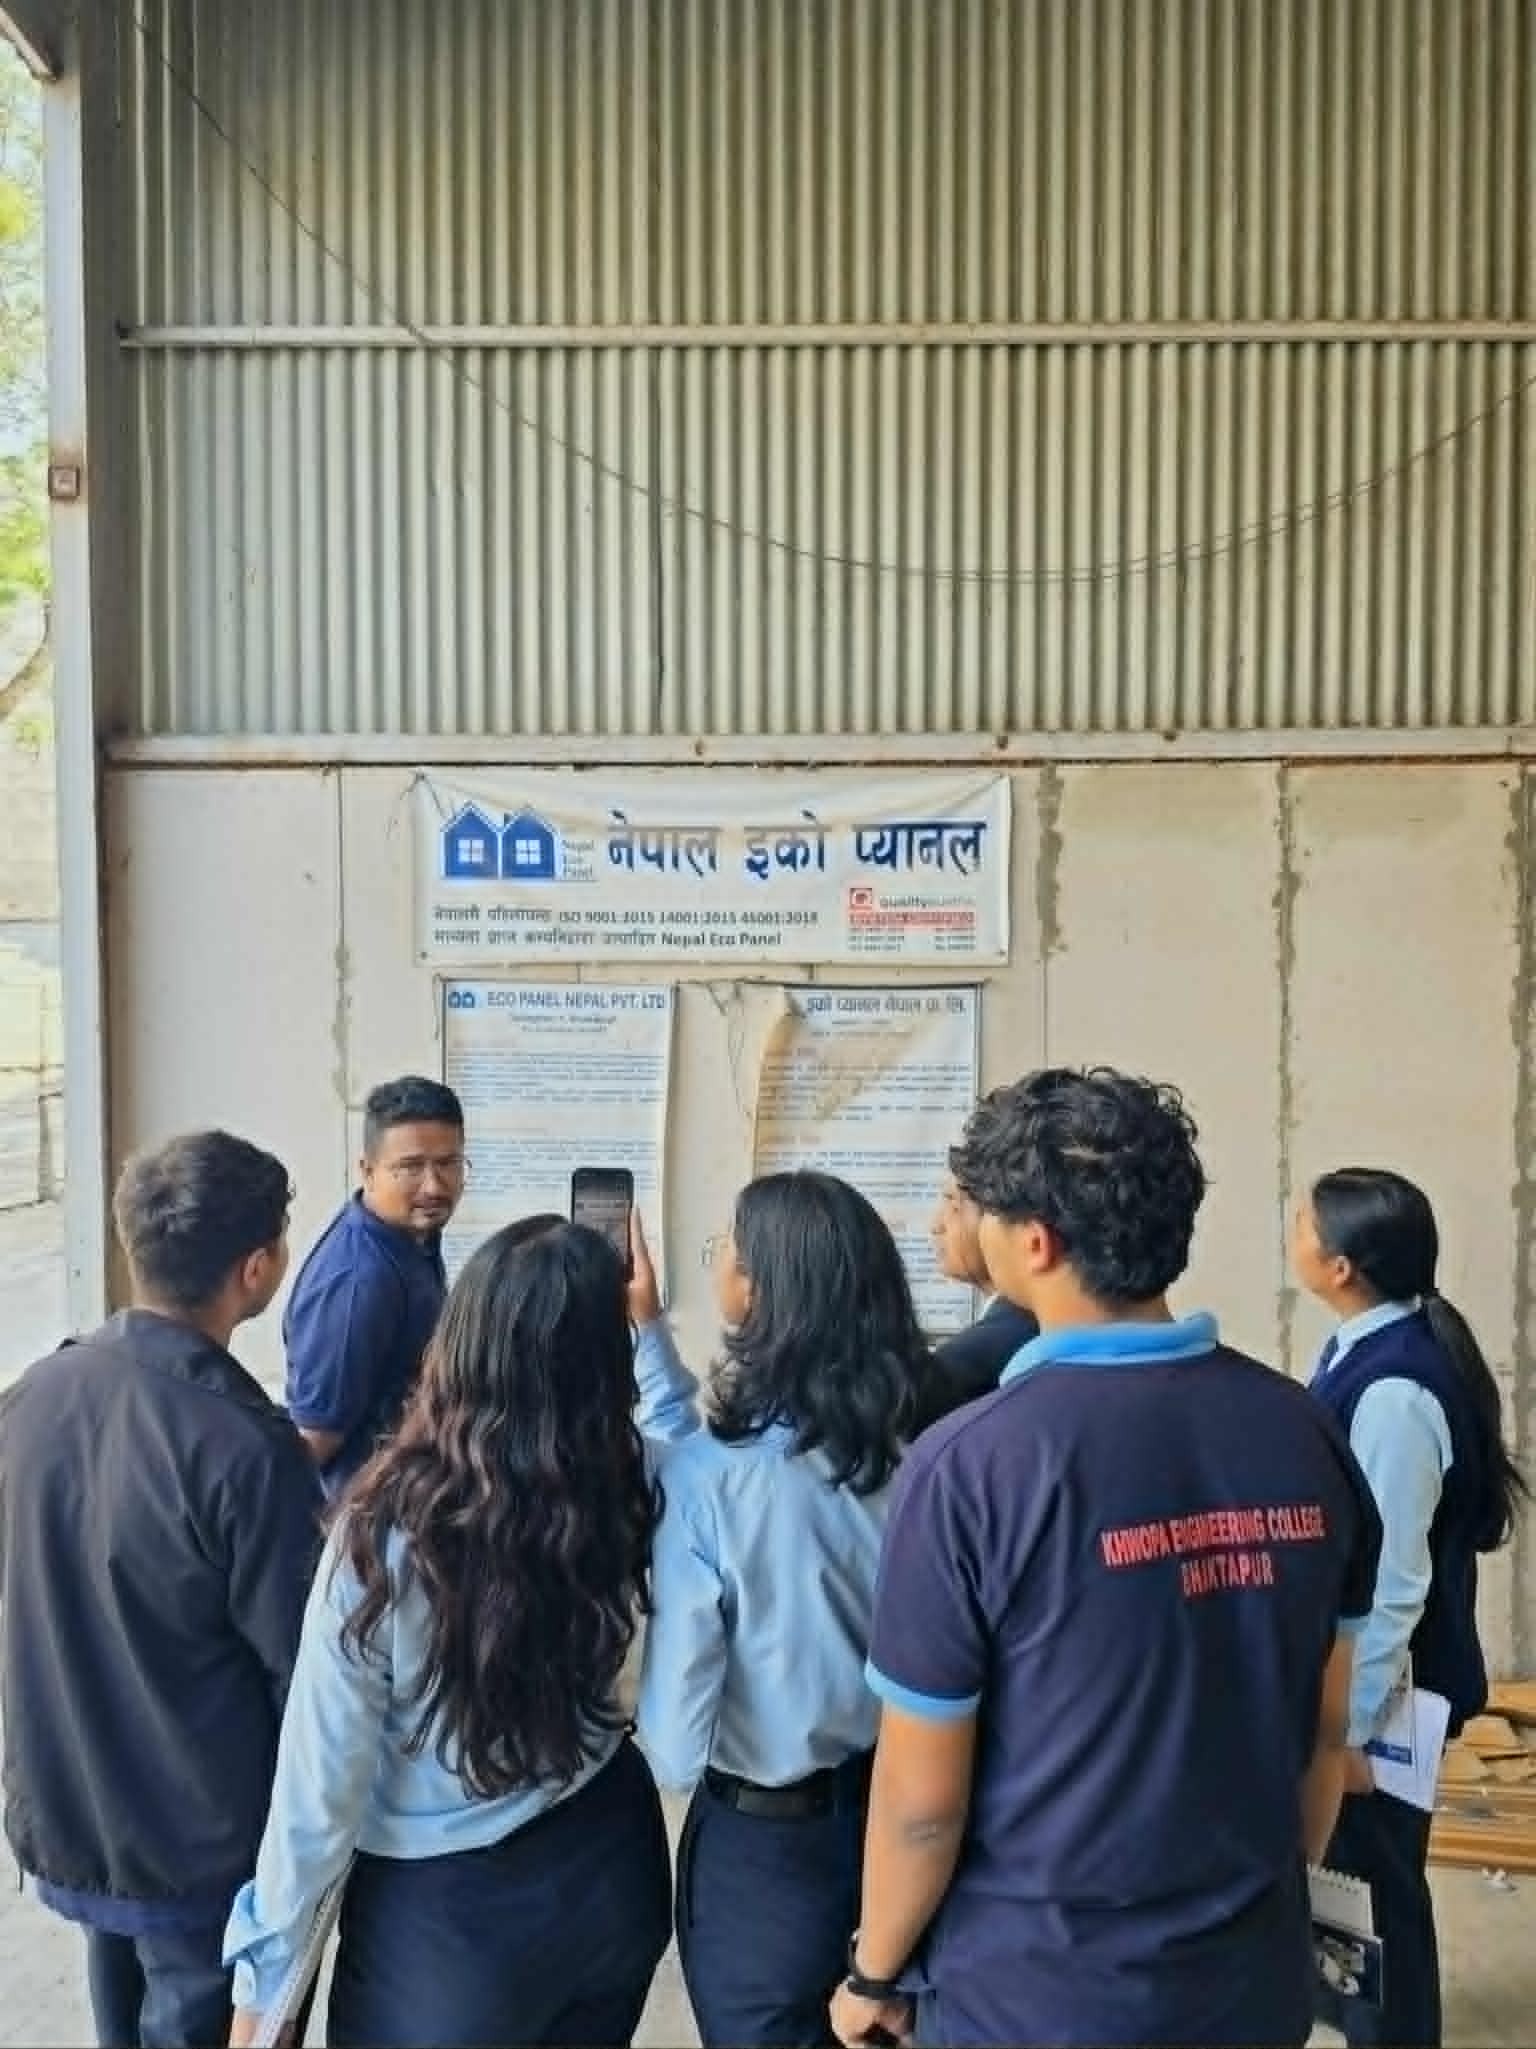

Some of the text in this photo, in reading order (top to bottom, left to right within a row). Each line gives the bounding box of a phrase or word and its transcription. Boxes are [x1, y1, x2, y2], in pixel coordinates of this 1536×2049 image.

[607, 808, 987, 880] नेपाल इको प्यानल
[559, 911, 581, 922] ISO
[661, 931, 705, 948] Nepal
[710, 931, 736, 945] Eco
[739, 931, 783, 945] Panel
[487, 992, 516, 1008] ECO
[520, 992, 560, 1008] PANEL
[565, 992, 607, 1008] NEPAL
[1168, 1509, 1265, 1553] ENGINEERING
[1266, 1506, 1325, 1540] COLLEGE
